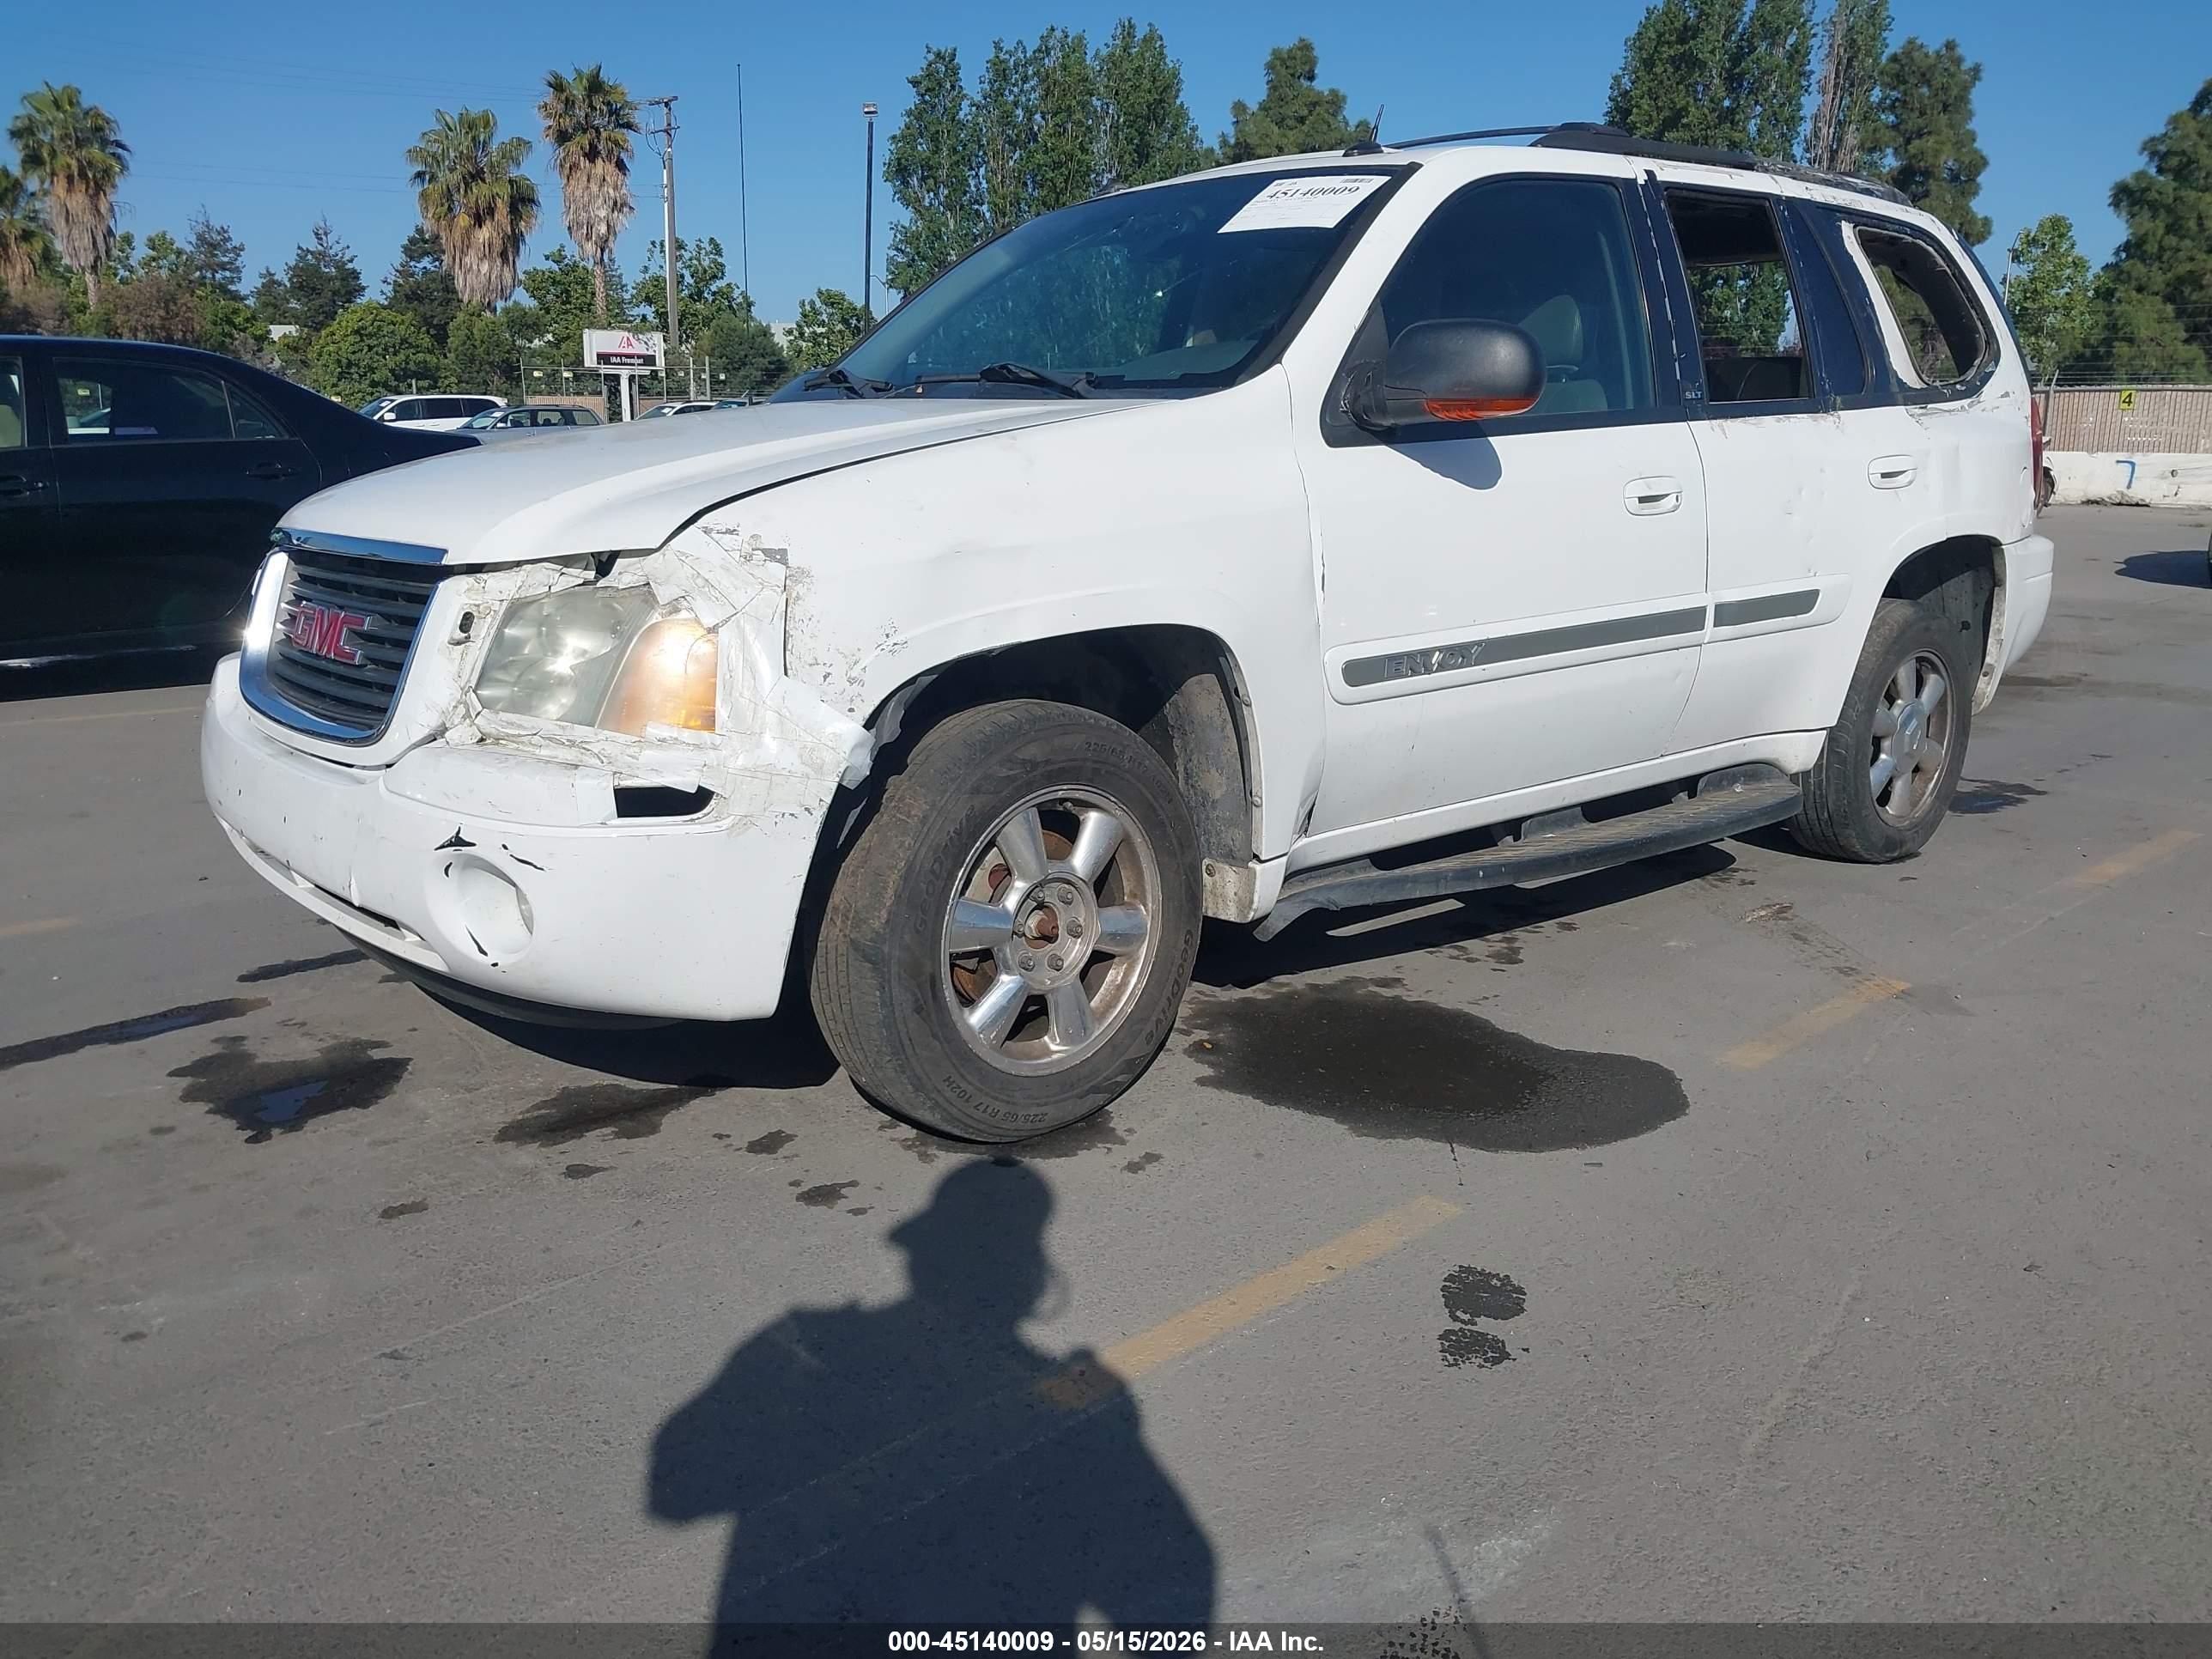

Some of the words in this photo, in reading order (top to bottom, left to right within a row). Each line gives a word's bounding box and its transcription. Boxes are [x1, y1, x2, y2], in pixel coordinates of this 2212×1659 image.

[1267, 185, 1360, 199] 45140009
[1685, 391, 1703, 399] SLT
[2121, 393, 2134, 407] 4
[2115, 459, 2136, 489] 7
[290, 601, 373, 665] GMC
[1384, 642, 1486, 678] ENVOY
[942, 1075, 973, 1104] 102H
[974, 1102, 1000, 1118] R17
[1001, 1111, 1049, 1124] 225/65
